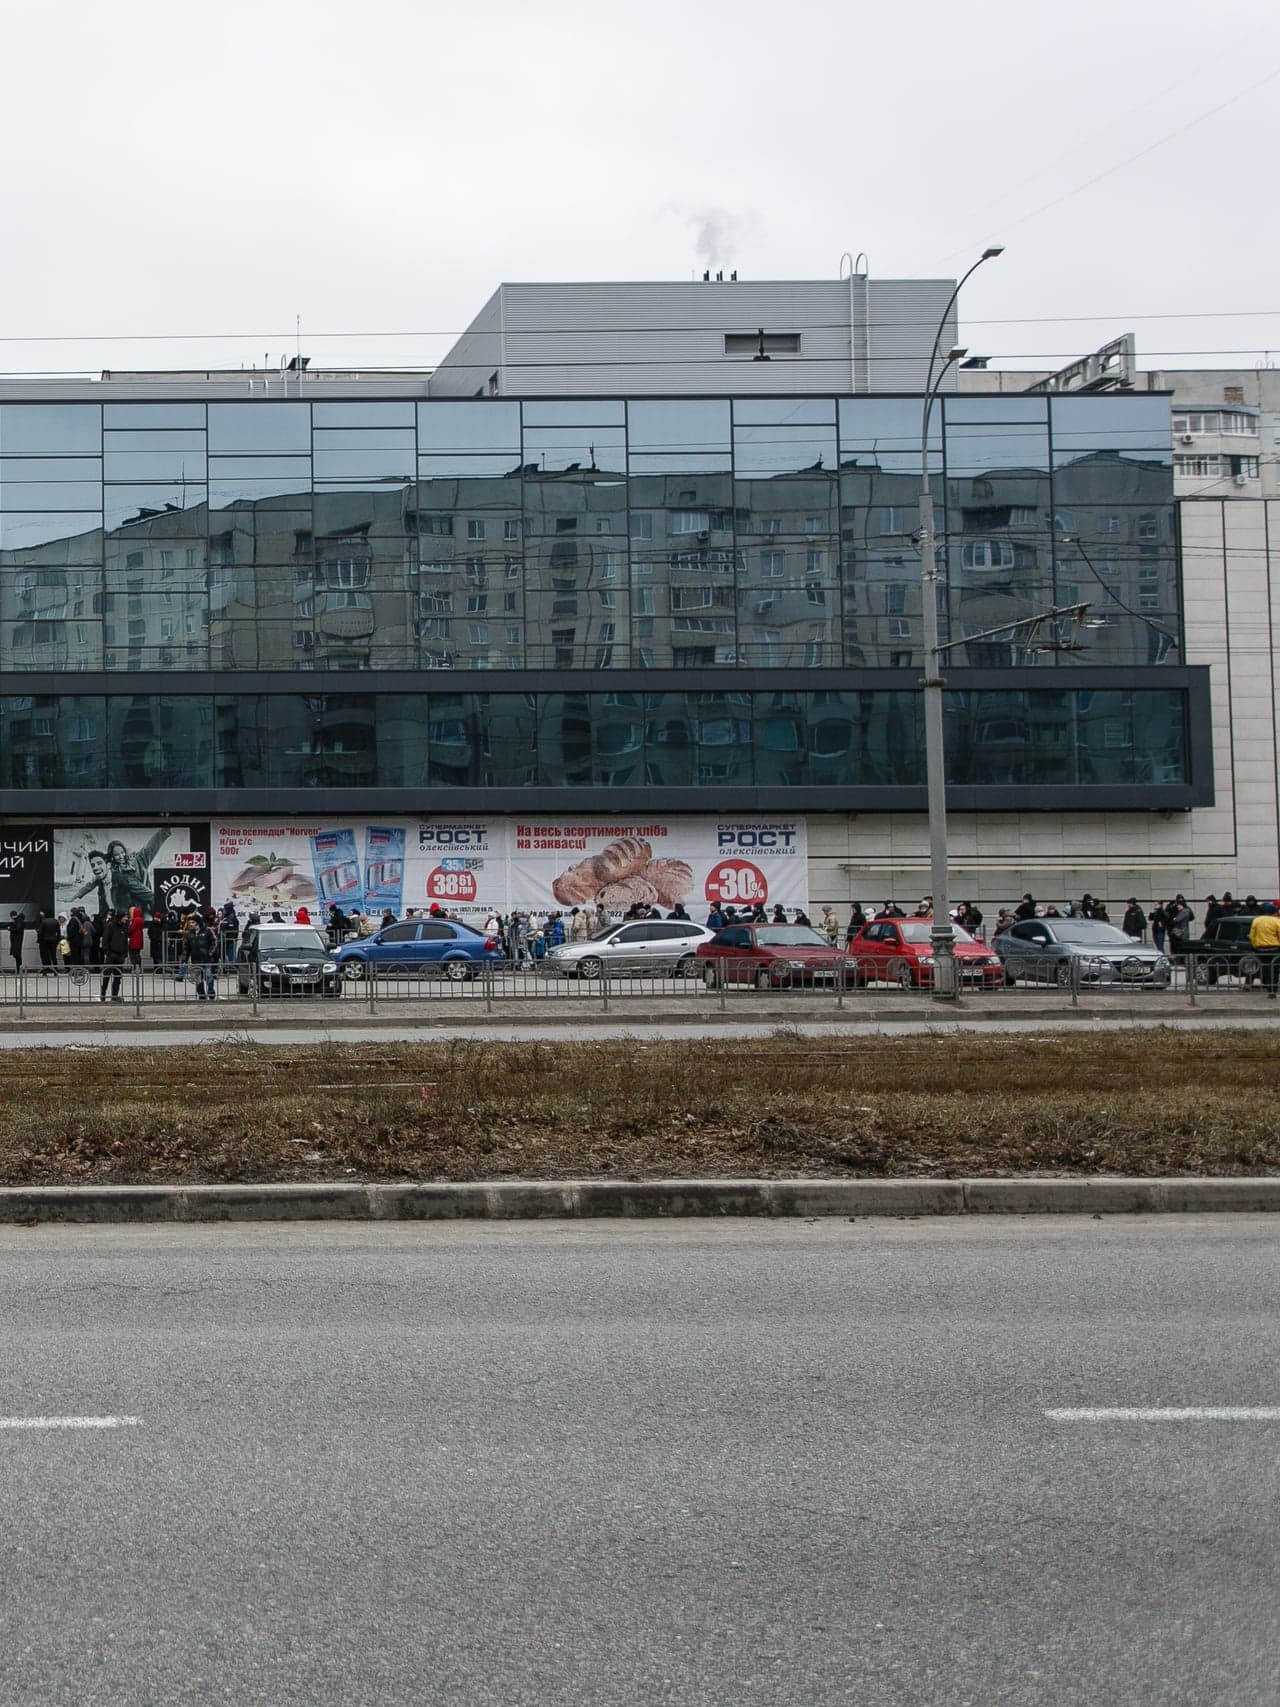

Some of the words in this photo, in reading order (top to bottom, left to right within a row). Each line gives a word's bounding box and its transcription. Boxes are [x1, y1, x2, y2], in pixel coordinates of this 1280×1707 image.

[219, 827, 241, 836] Філе
[419, 830, 487, 844] РОСТ
[517, 825, 531, 836] На
[534, 826, 562, 837] весь
[564, 826, 634, 838] асортимент
[636, 825, 668, 837] хліба
[718, 831, 796, 847] РОСТ
[517, 839, 531, 849] на
[534, 838, 586, 850] заквасці
[160, 874, 206, 893] МОДНІ
[433, 873, 459, 895] 38
[708, 868, 765, 900] -30%
